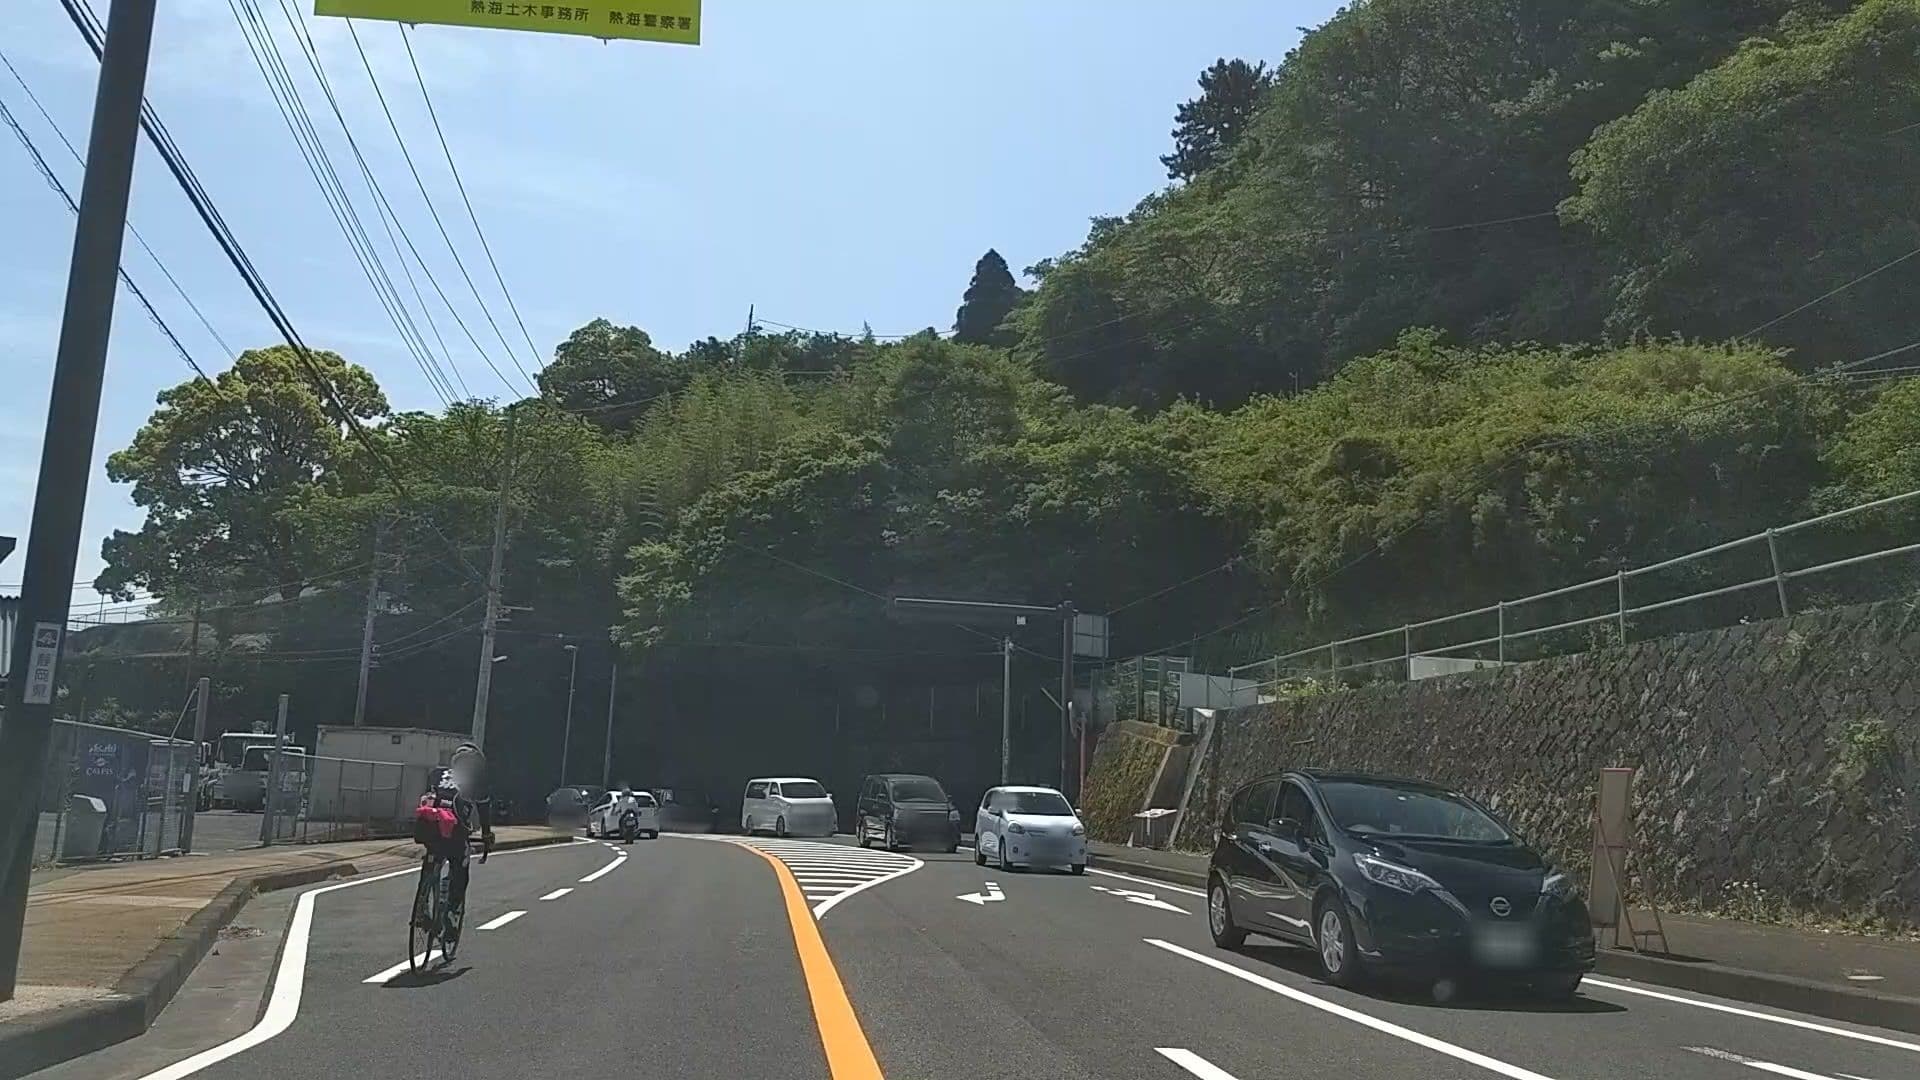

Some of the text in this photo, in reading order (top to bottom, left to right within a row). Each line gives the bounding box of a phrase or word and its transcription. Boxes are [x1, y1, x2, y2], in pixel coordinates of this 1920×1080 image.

[471, 0, 692, 30] 熱海土木事務所 熱海警察署
